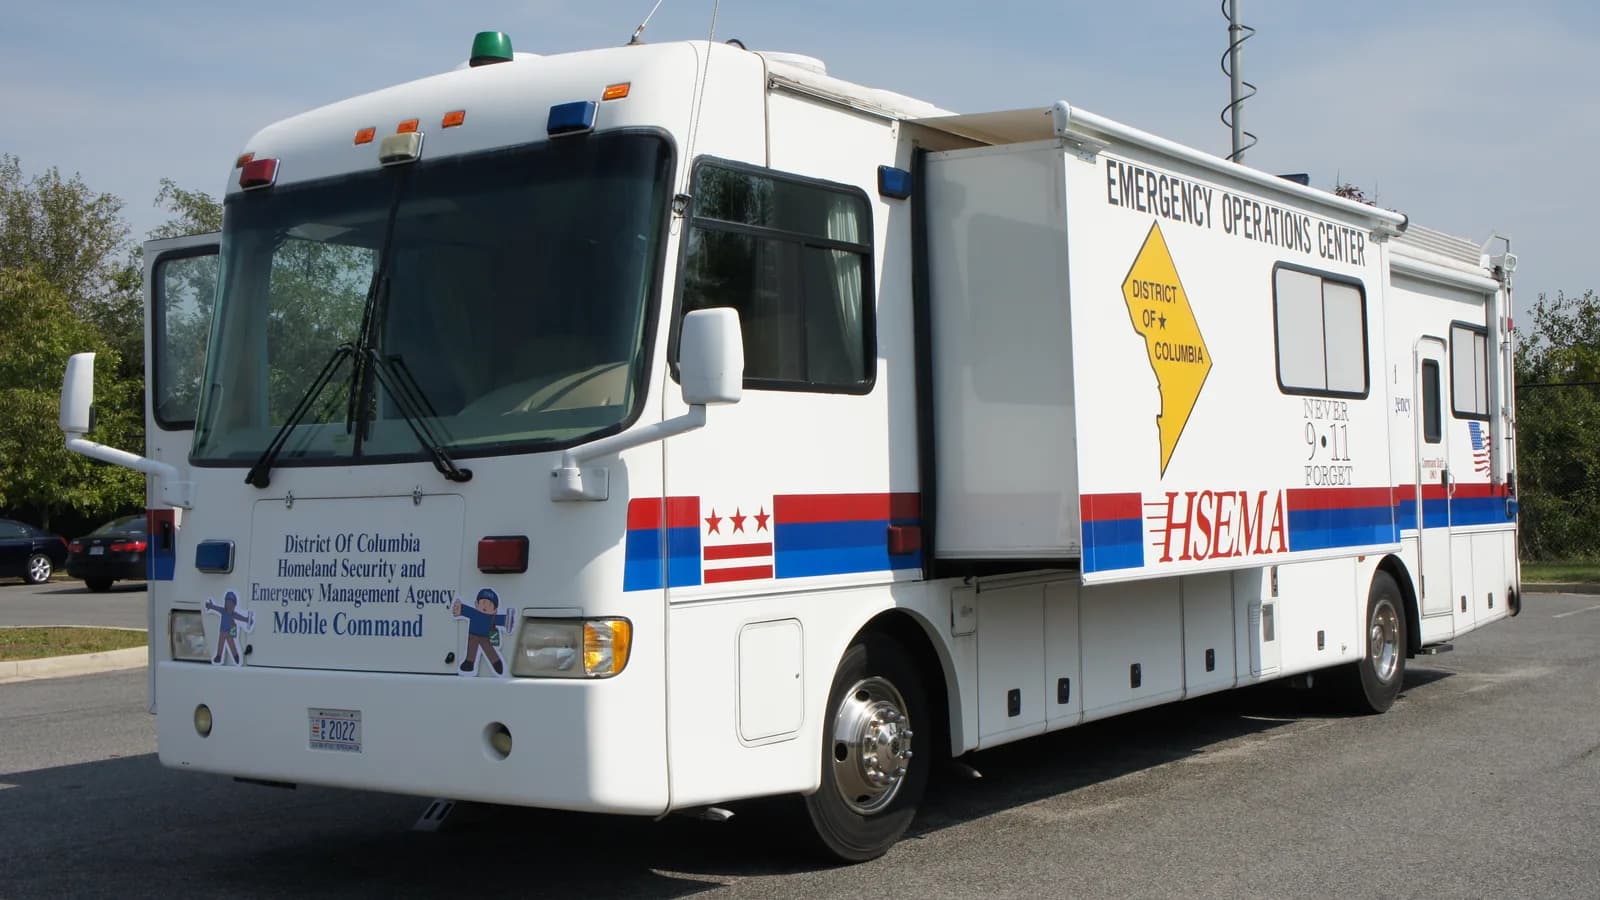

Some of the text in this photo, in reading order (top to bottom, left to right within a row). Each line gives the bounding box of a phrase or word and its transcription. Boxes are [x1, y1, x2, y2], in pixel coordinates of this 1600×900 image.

[1106, 159, 1366, 267] EMERGENCY OPERATIONS CENTER
[1132, 279, 1177, 304] DISTRICT
[1142, 309, 1156, 328] OF
[1154, 341, 1204, 364] COLUMBIA
[1303, 398, 1350, 422] NEVER
[1304, 465, 1354, 486] FORGET
[1159, 488, 1288, 563] HSEMA
[284, 533, 421, 554] District Of Columbia
[277, 558, 426, 583] Homeland Security and
[251, 583, 456, 610] Emergency Management Agency
[272, 611, 423, 638] Mobile Command
[329, 720, 356, 742] 2022
